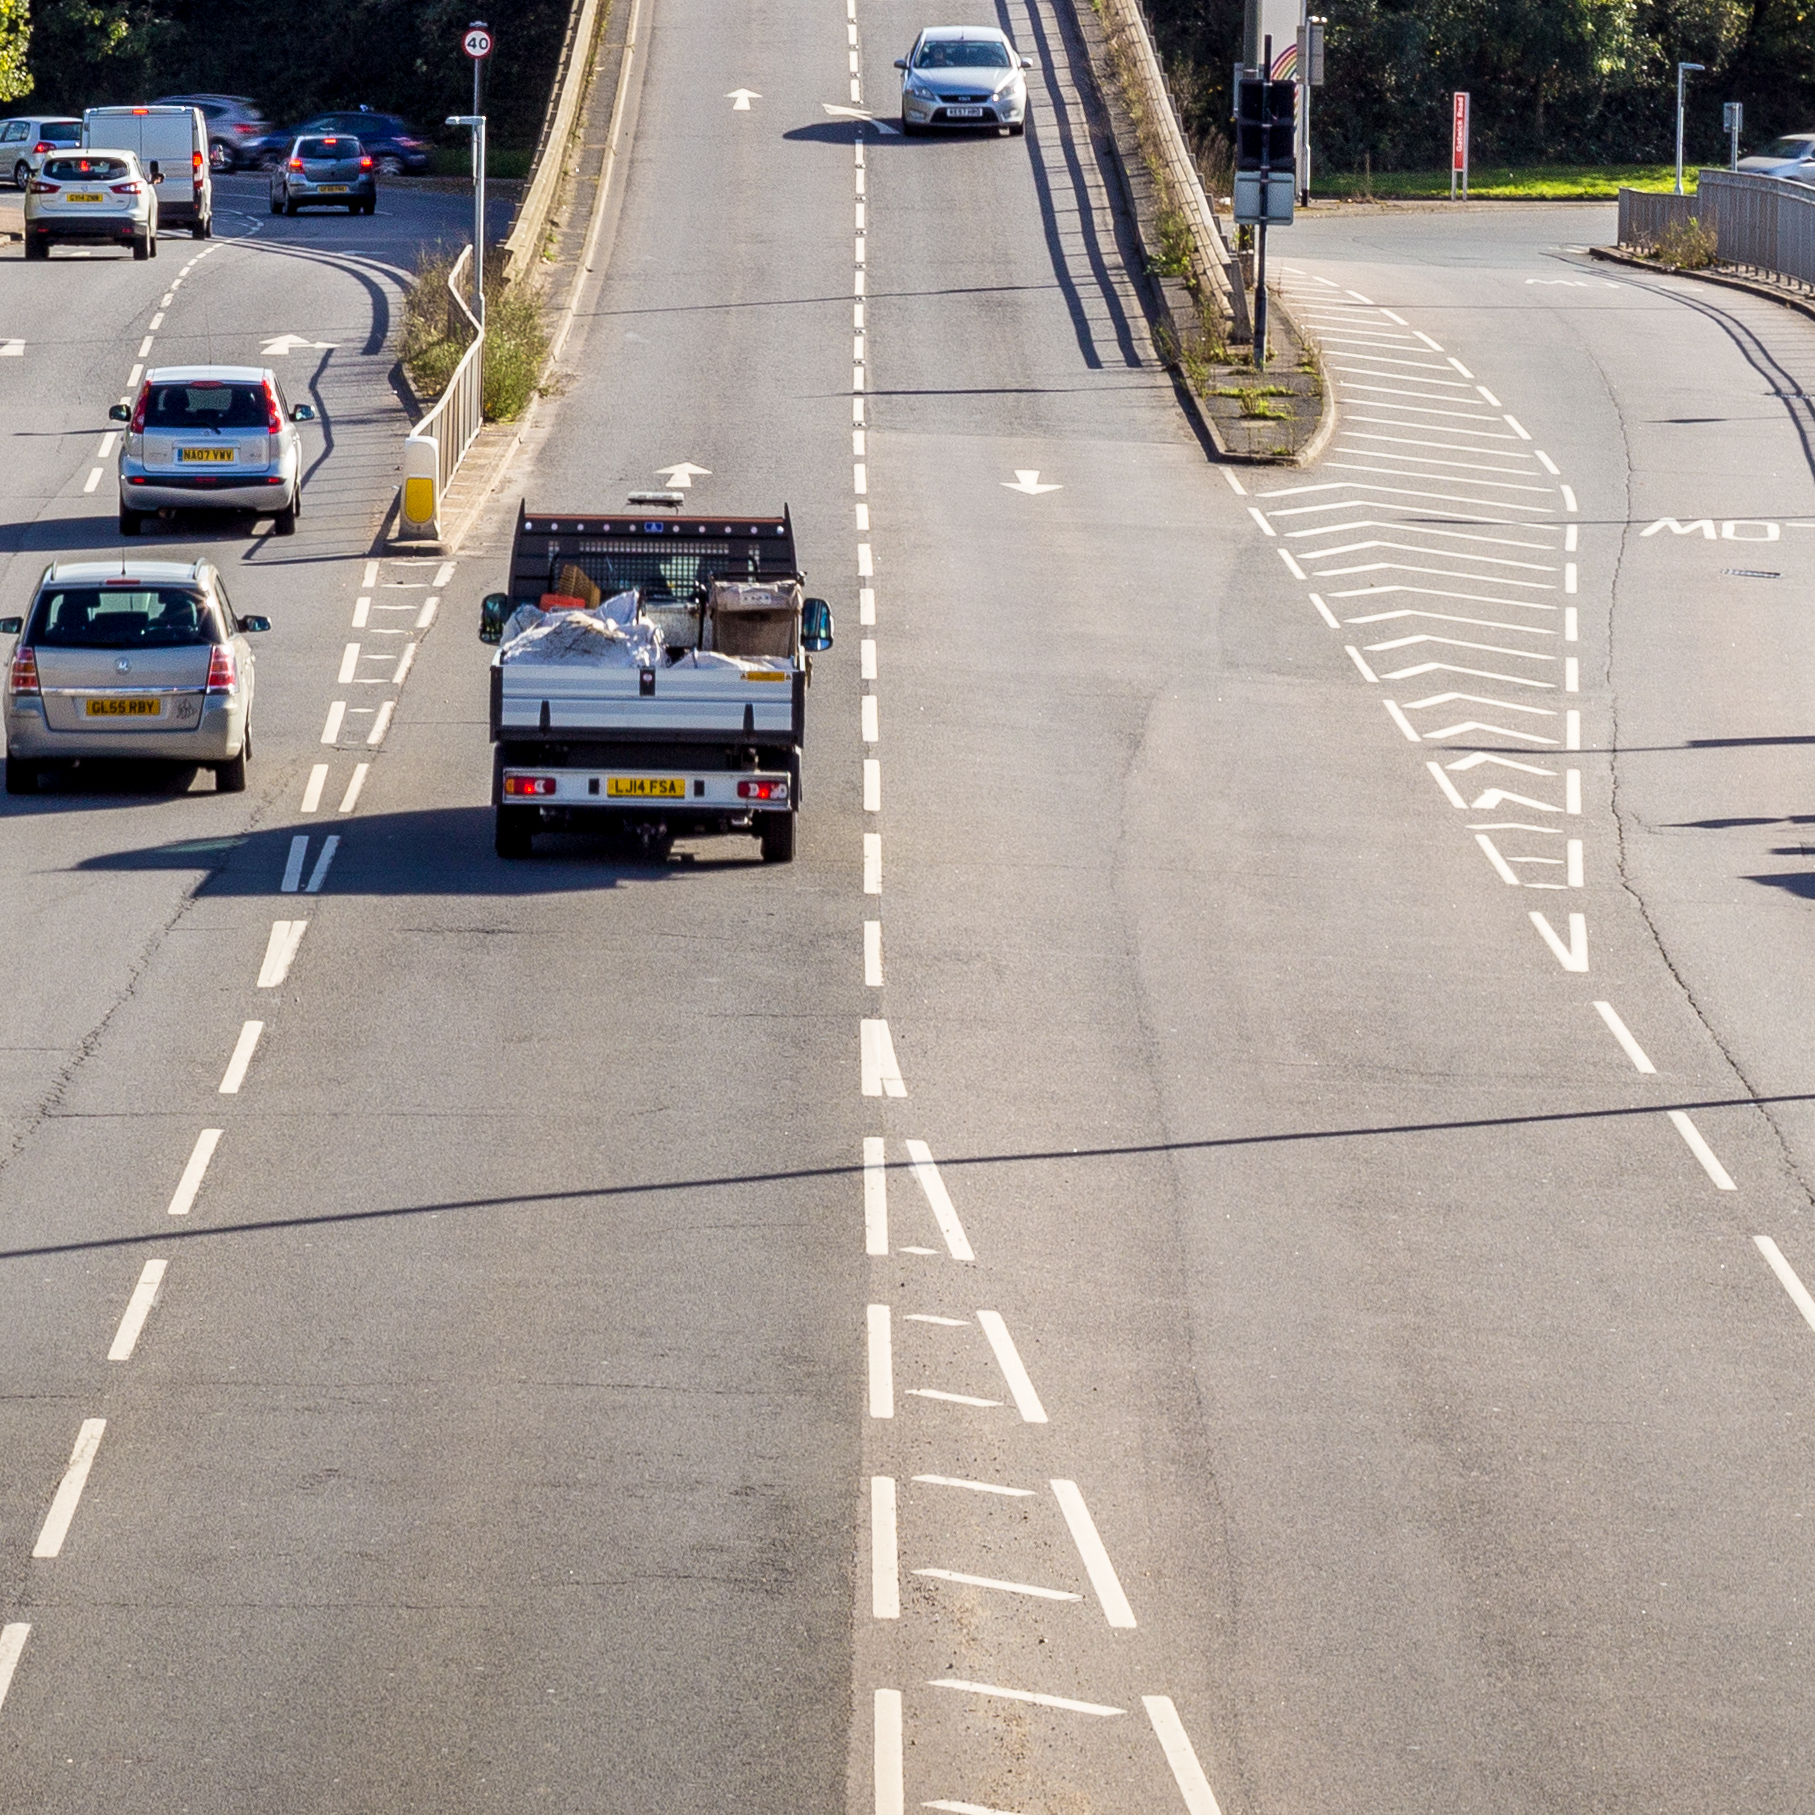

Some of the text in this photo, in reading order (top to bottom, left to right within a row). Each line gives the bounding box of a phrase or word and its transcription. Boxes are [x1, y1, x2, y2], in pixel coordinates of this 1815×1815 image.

[467, 37, 488, 50] 40
[184, 448, 210, 461] NA07
[91, 700, 155, 714] GL55 RBY
[615, 779, 676, 794] LJ14 FSA
